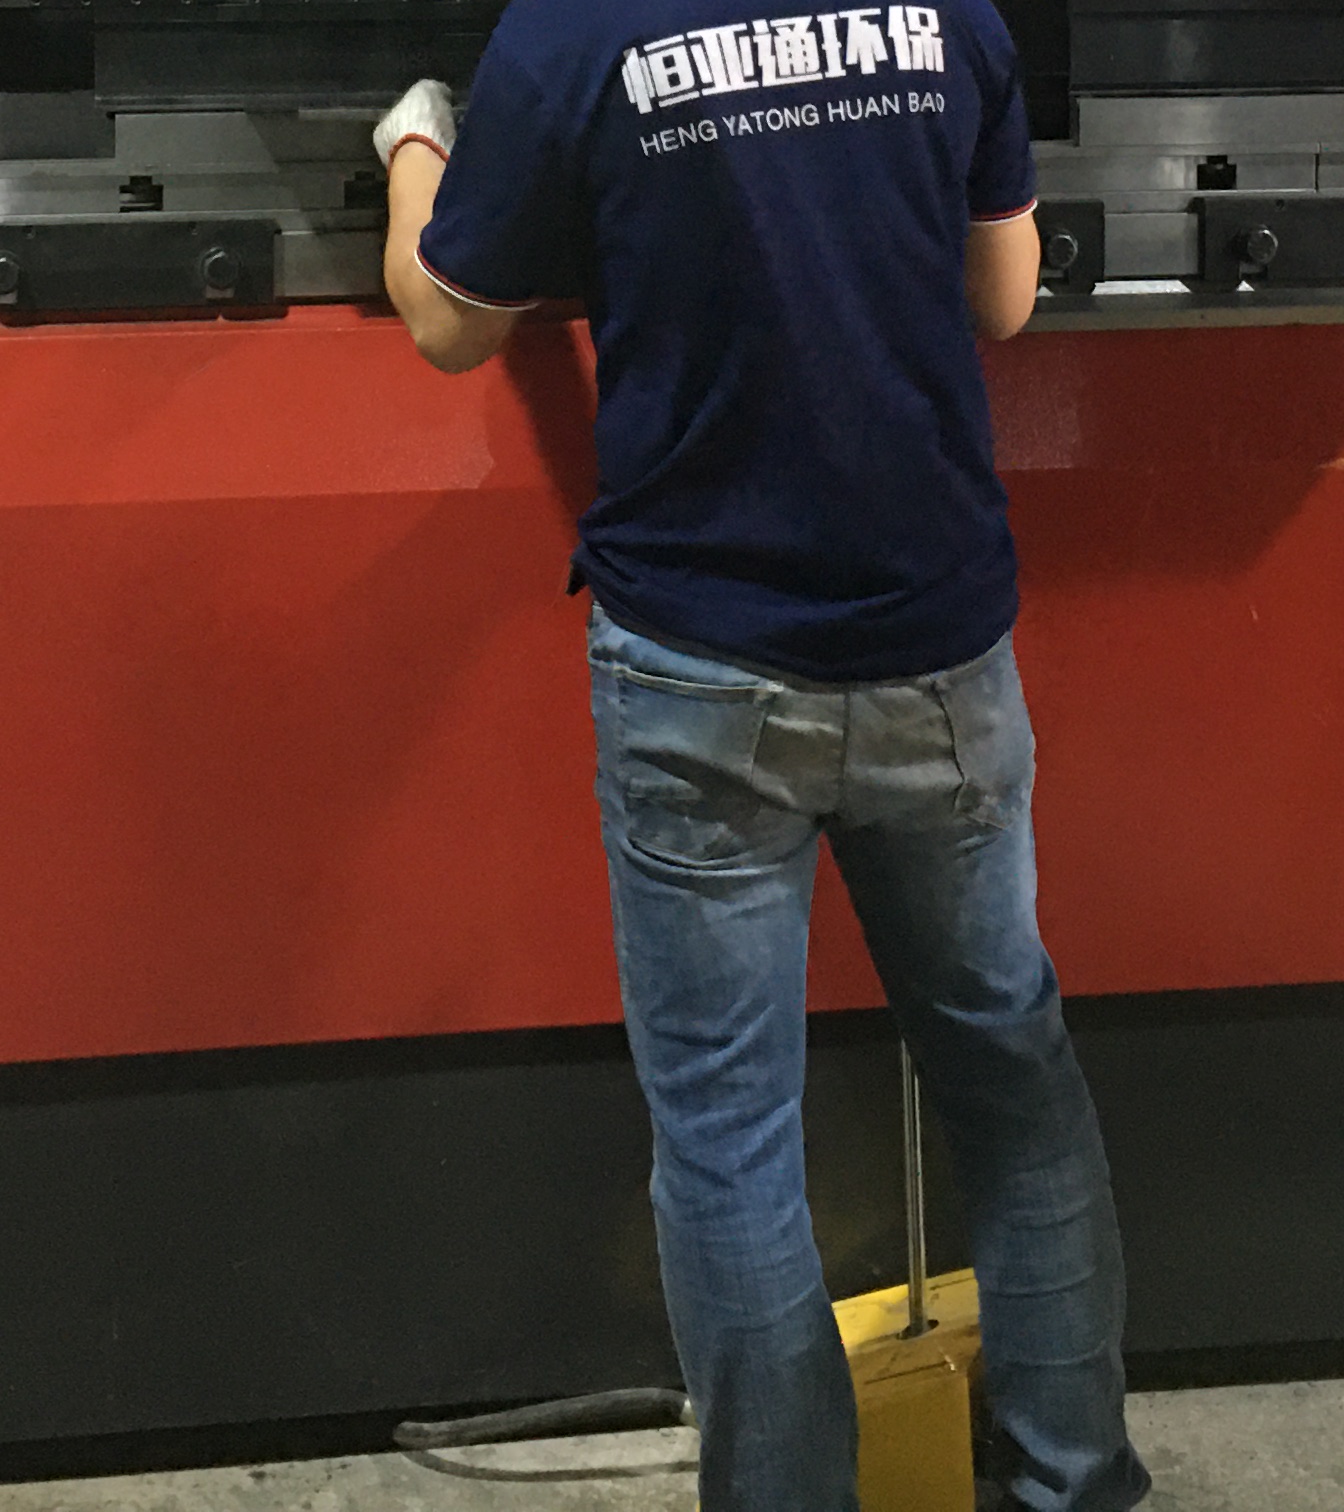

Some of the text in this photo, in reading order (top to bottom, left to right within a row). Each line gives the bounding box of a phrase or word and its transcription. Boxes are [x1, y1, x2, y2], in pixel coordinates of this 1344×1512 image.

[621, 4, 945, 115] 恒亚通环保
[639, 91, 946, 158] HENG YATONG HUAN BAO
